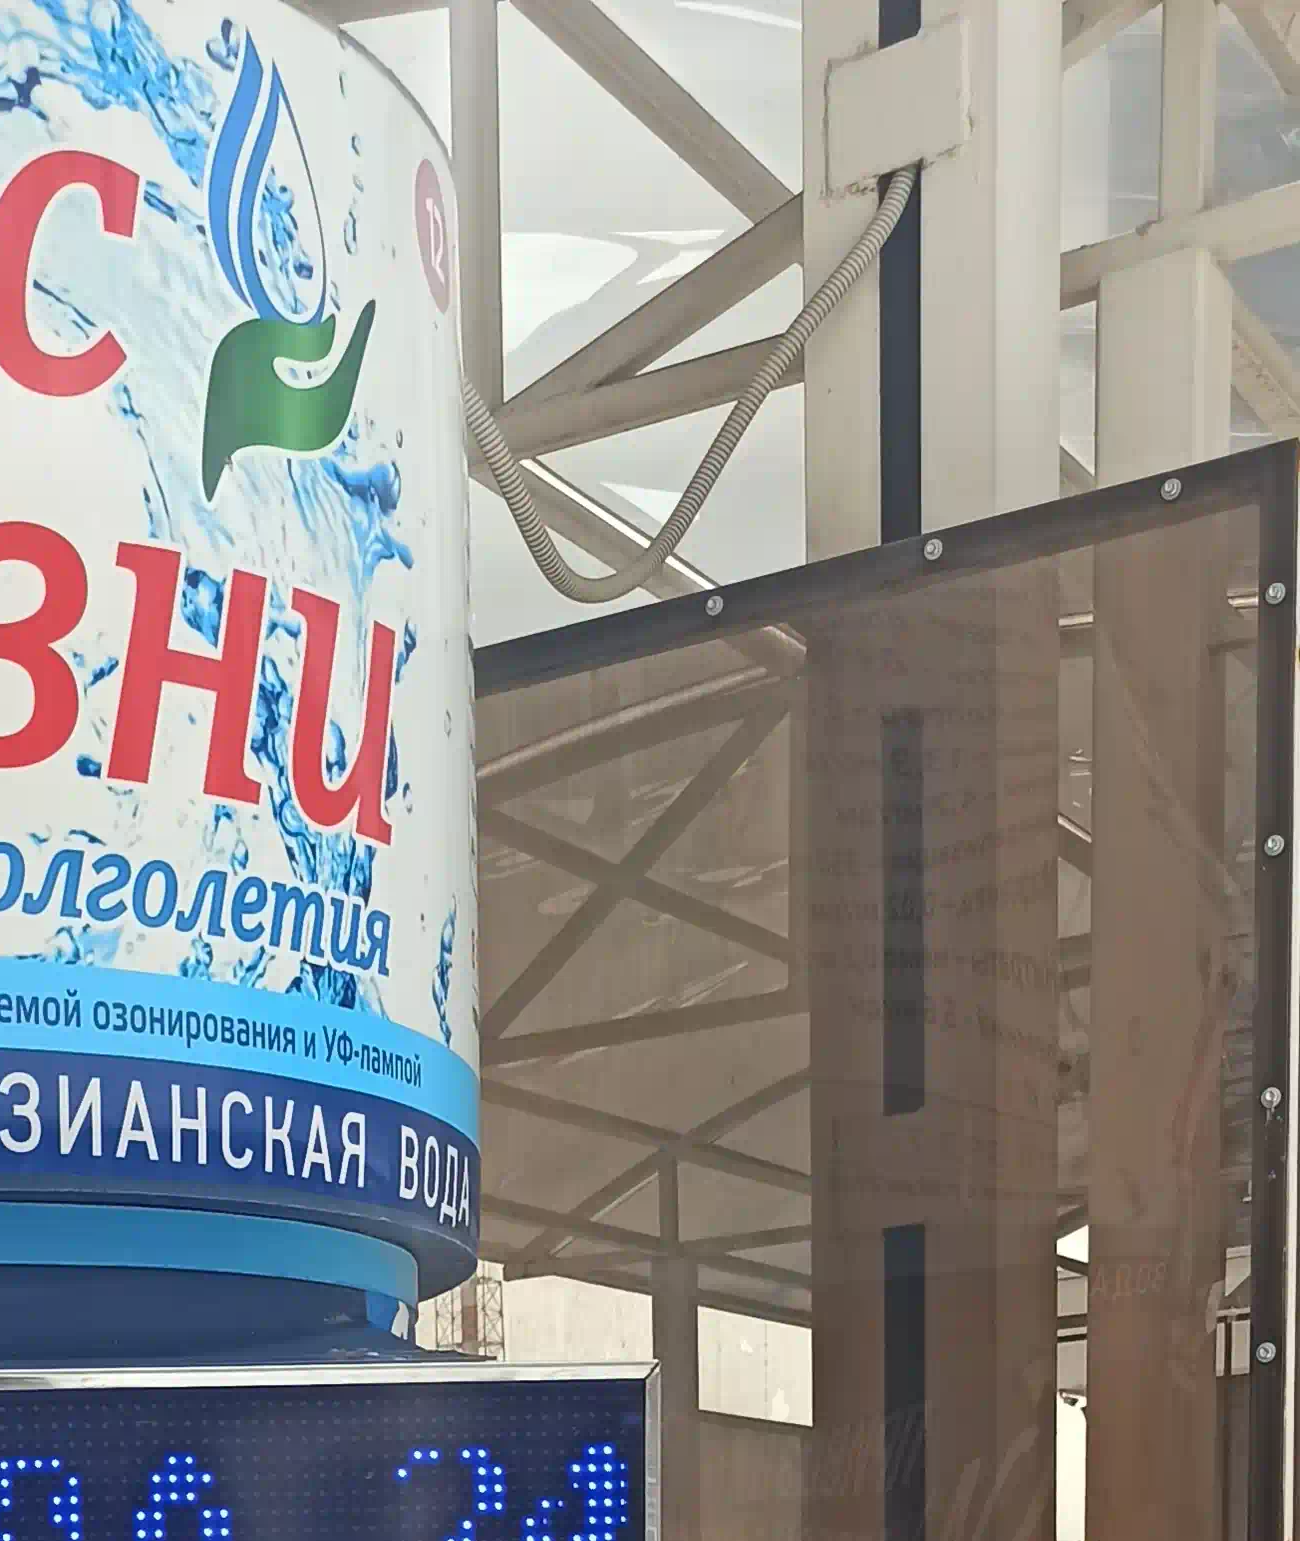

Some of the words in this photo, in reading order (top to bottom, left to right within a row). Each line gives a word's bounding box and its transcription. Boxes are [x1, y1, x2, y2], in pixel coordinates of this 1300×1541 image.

[93, 1000, 297, 1057] озонирования
[303, 1026, 317, 1060] и
[322, 1022, 422, 1090] УФ-лампой
[399, 1123, 471, 1229] ВОДА
